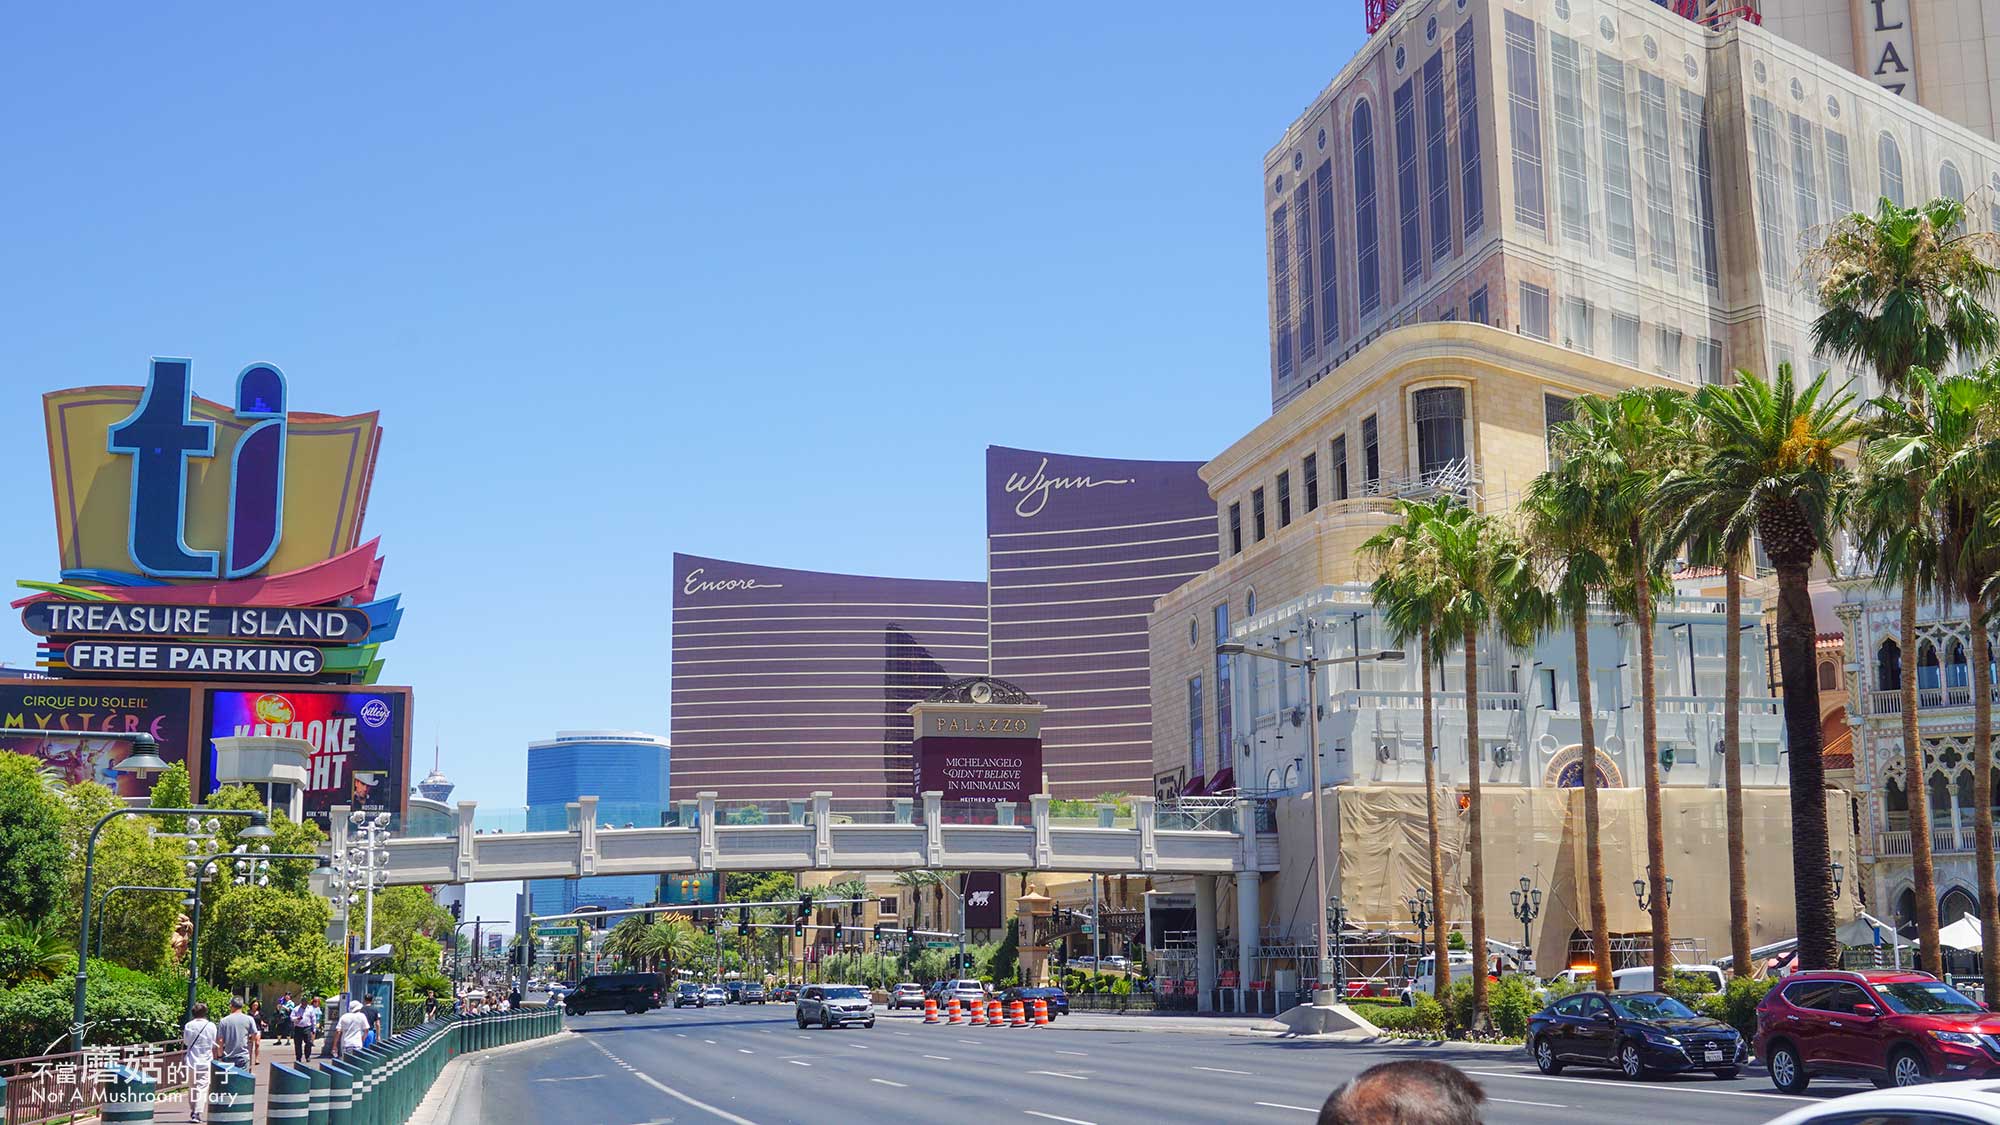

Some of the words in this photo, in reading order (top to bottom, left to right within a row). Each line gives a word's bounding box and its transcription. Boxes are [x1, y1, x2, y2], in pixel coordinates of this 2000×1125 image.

[107, 356, 289, 579] ti
[684, 568, 783, 595] Encore
[47, 604, 210, 634] TREASURE
[232, 609, 349, 638] ISLAND
[72, 645, 158, 669] FREE
[169, 647, 316, 673] PARKING
[23, 695, 75, 710] CIRQUE
[78, 696, 98, 708] DU
[101, 697, 148, 709] SOLEIL
[937, 718, 1028, 733] PALAZZO
[946, 758, 1023, 768] MICHELANGELO
[942, 768, 984, 779] DIDN'T
[984, 769, 1021, 779] BELIEVE
[948, 780, 959, 790] IN
[960, 781, 1020, 791] MINIMALISM
